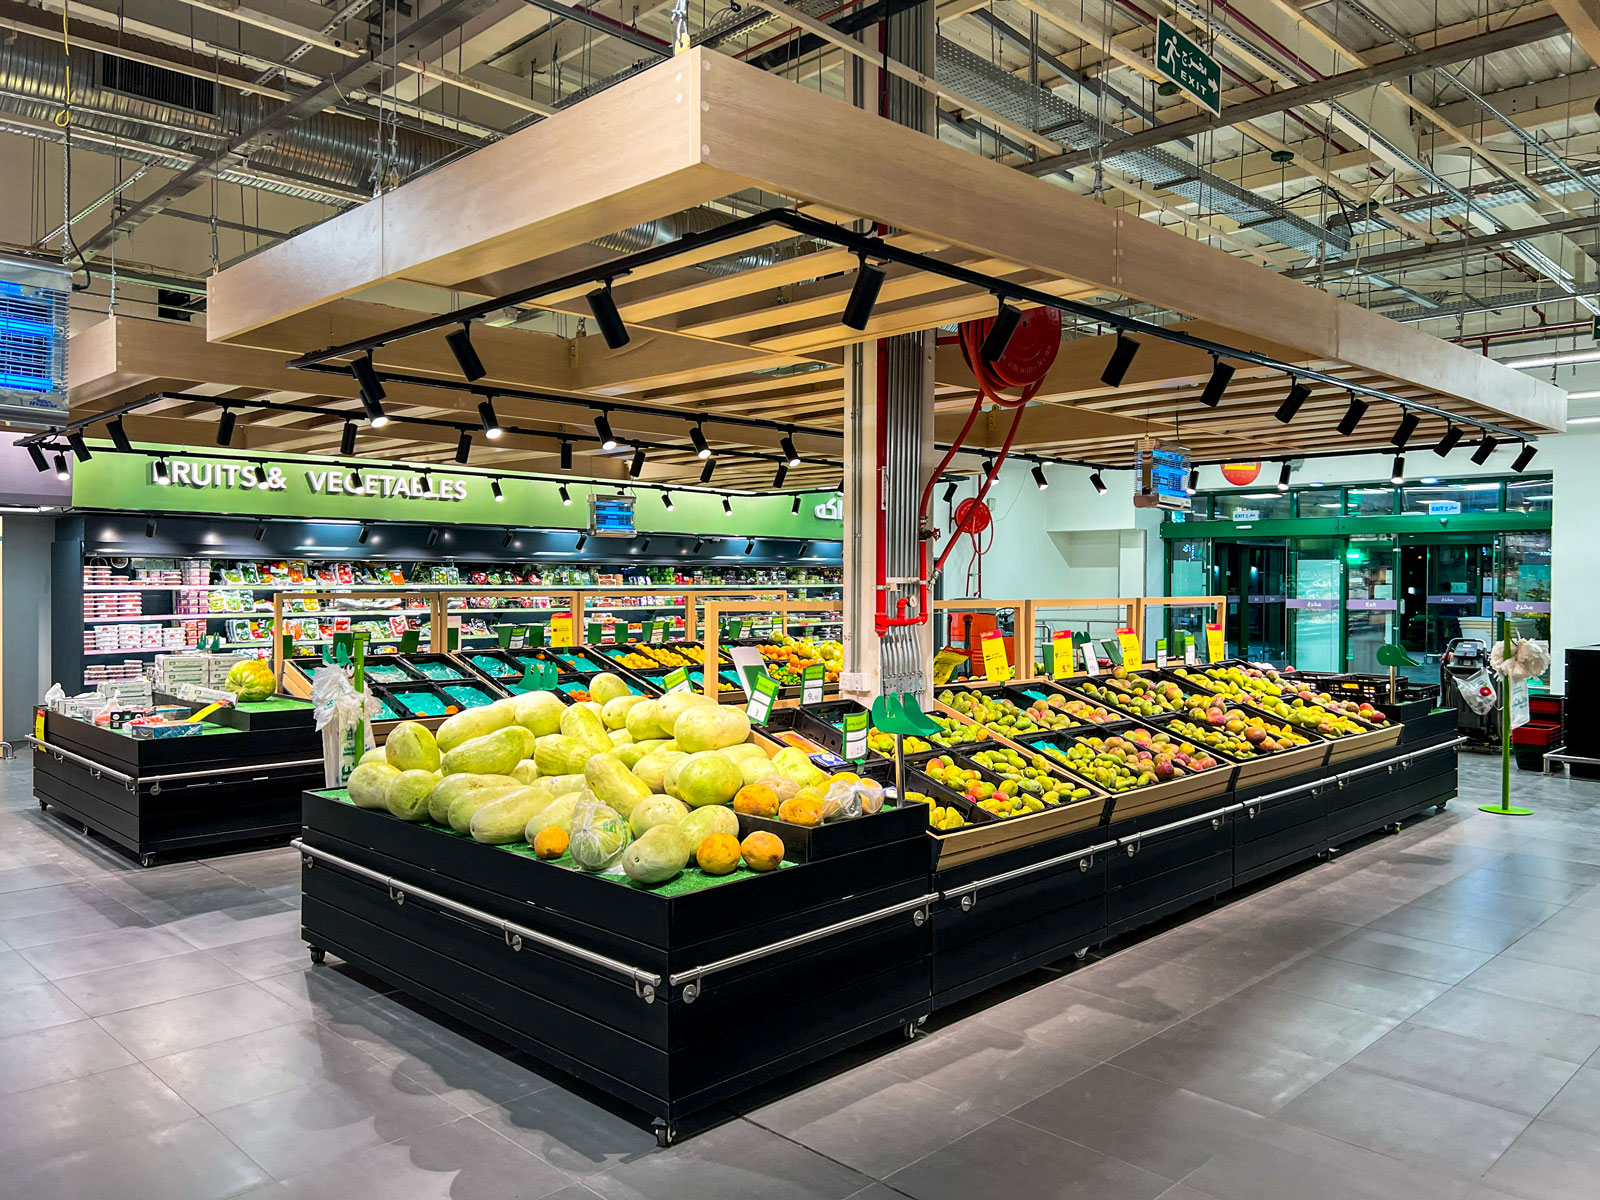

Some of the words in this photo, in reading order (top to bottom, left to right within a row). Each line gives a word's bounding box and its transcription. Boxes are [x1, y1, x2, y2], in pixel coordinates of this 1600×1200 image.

[1181, 70, 1207, 95] EXIT
[267, 467, 288, 489] &
[1515, 603, 1534, 611] مخرج
